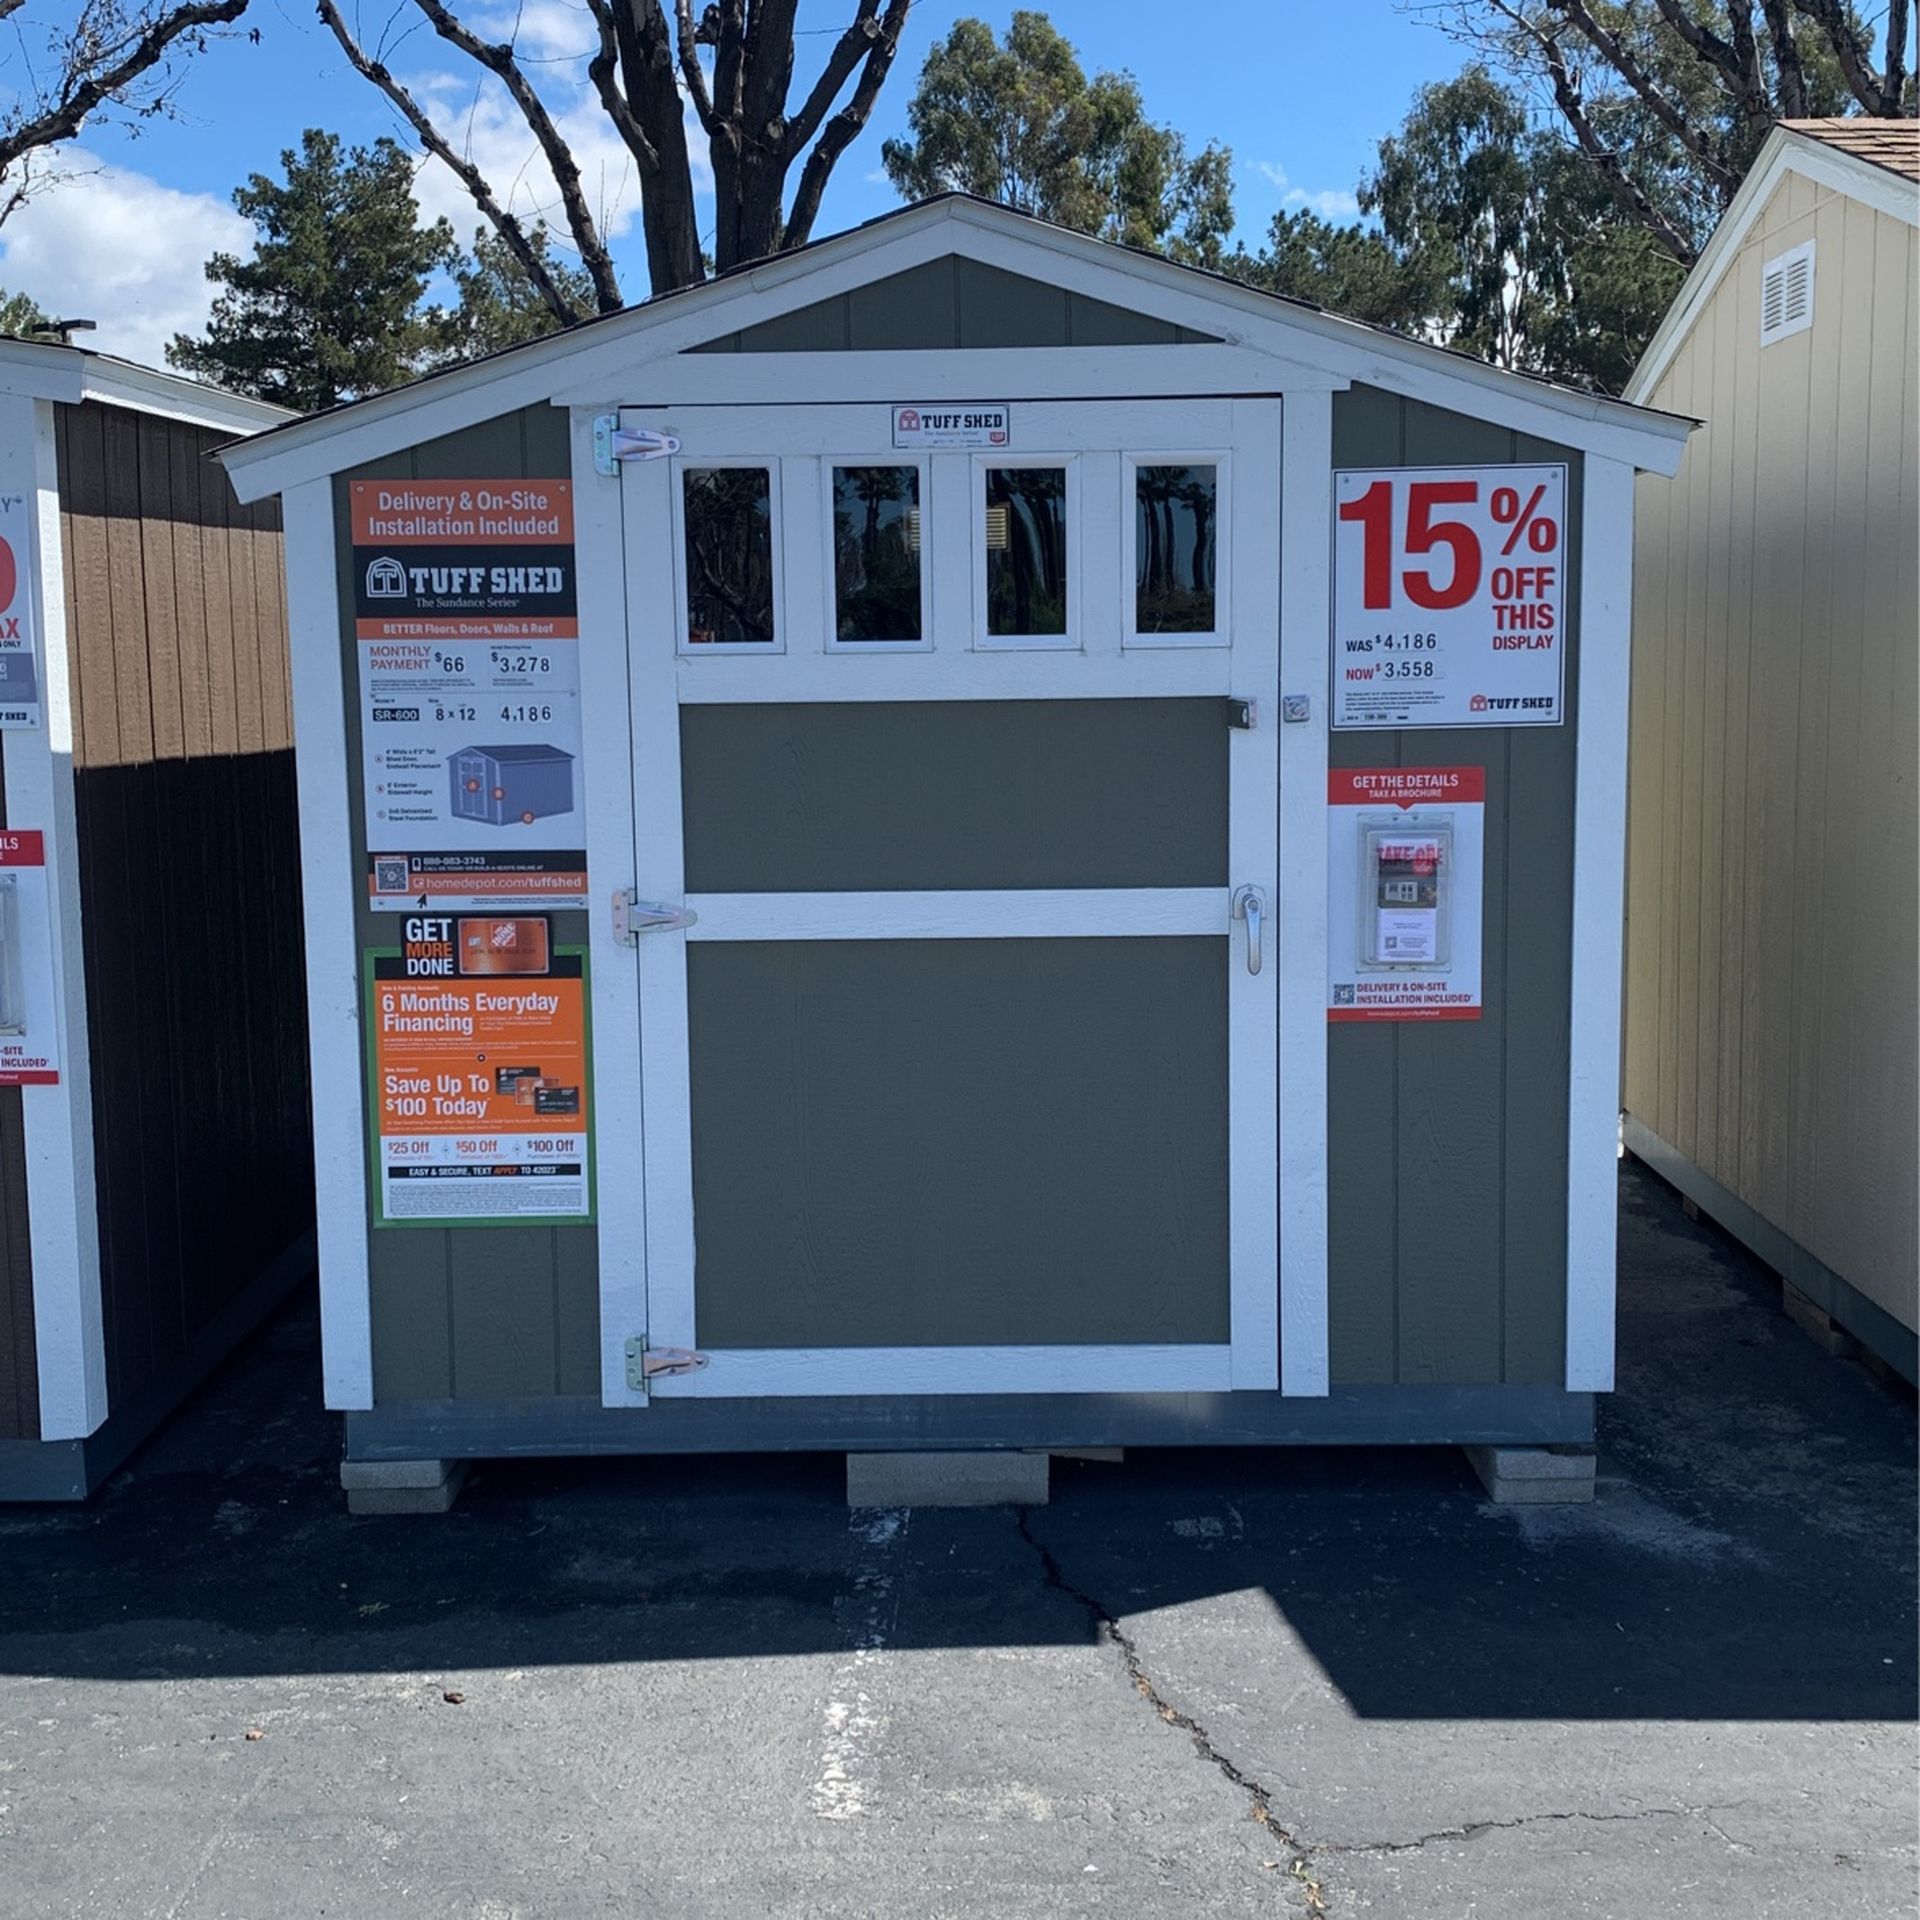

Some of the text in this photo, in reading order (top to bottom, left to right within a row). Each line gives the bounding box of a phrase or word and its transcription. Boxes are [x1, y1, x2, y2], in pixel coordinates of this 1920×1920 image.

[921, 414, 1003, 429] TUFF SHED
[378, 490, 548, 515] Delivery & On-Site
[368, 515, 559, 536] Installation Included
[1339, 480, 1558, 611] 15%
[409, 566, 564, 594] TUFF SHED
[1491, 567, 1556, 601] OFF
[416, 598, 434, 608] The
[436, 598, 485, 608] Sundance
[1492, 603, 1554, 631] THIS
[0, 617, 21, 640] X
[383, 622, 554, 636] BETTER Floors, Doors, Walls & Roof
[1346, 640, 1373, 652] WAS
[1492, 634, 1554, 651] DISPLAY
[370, 646, 432, 657] MONTHLY
[370, 658, 431, 670] PAYMENT
[1346, 668, 1374, 681] NOW
[1488, 697, 1554, 710] TUFF SHED
[436, 708, 444, 721] 8
[458, 708, 476, 721] 12
[1352, 774, 1460, 788] GET THE DETAILS
[1369, 788, 1442, 798] TAKE A BROCHURE
[426, 876, 582, 890] homedepot.com/tuffshed
[406, 918, 452, 942] GET
[406, 943, 454, 959] MORE
[407, 959, 454, 976] DONE
[1356, 982, 1448, 992] DELIVERY & ON-SITE
[382, 992, 559, 1015] 6 Months Everyday
[1356, 995, 1423, 1004] INSTALLATION
[383, 1013, 473, 1035] Financing
[385, 1074, 490, 1096] Save Up To
[385, 1097, 488, 1118] $100 Today
[388, 1141, 430, 1154] $25 Off
[456, 1140, 498, 1153] $50 Off
[527, 1140, 574, 1152] $100 Off
[408, 1168, 430, 1176] EASY
[431, 1168, 438, 1176] &
[472, 1166, 492, 1176] TEXT
[521, 1166, 531, 1175] TO
